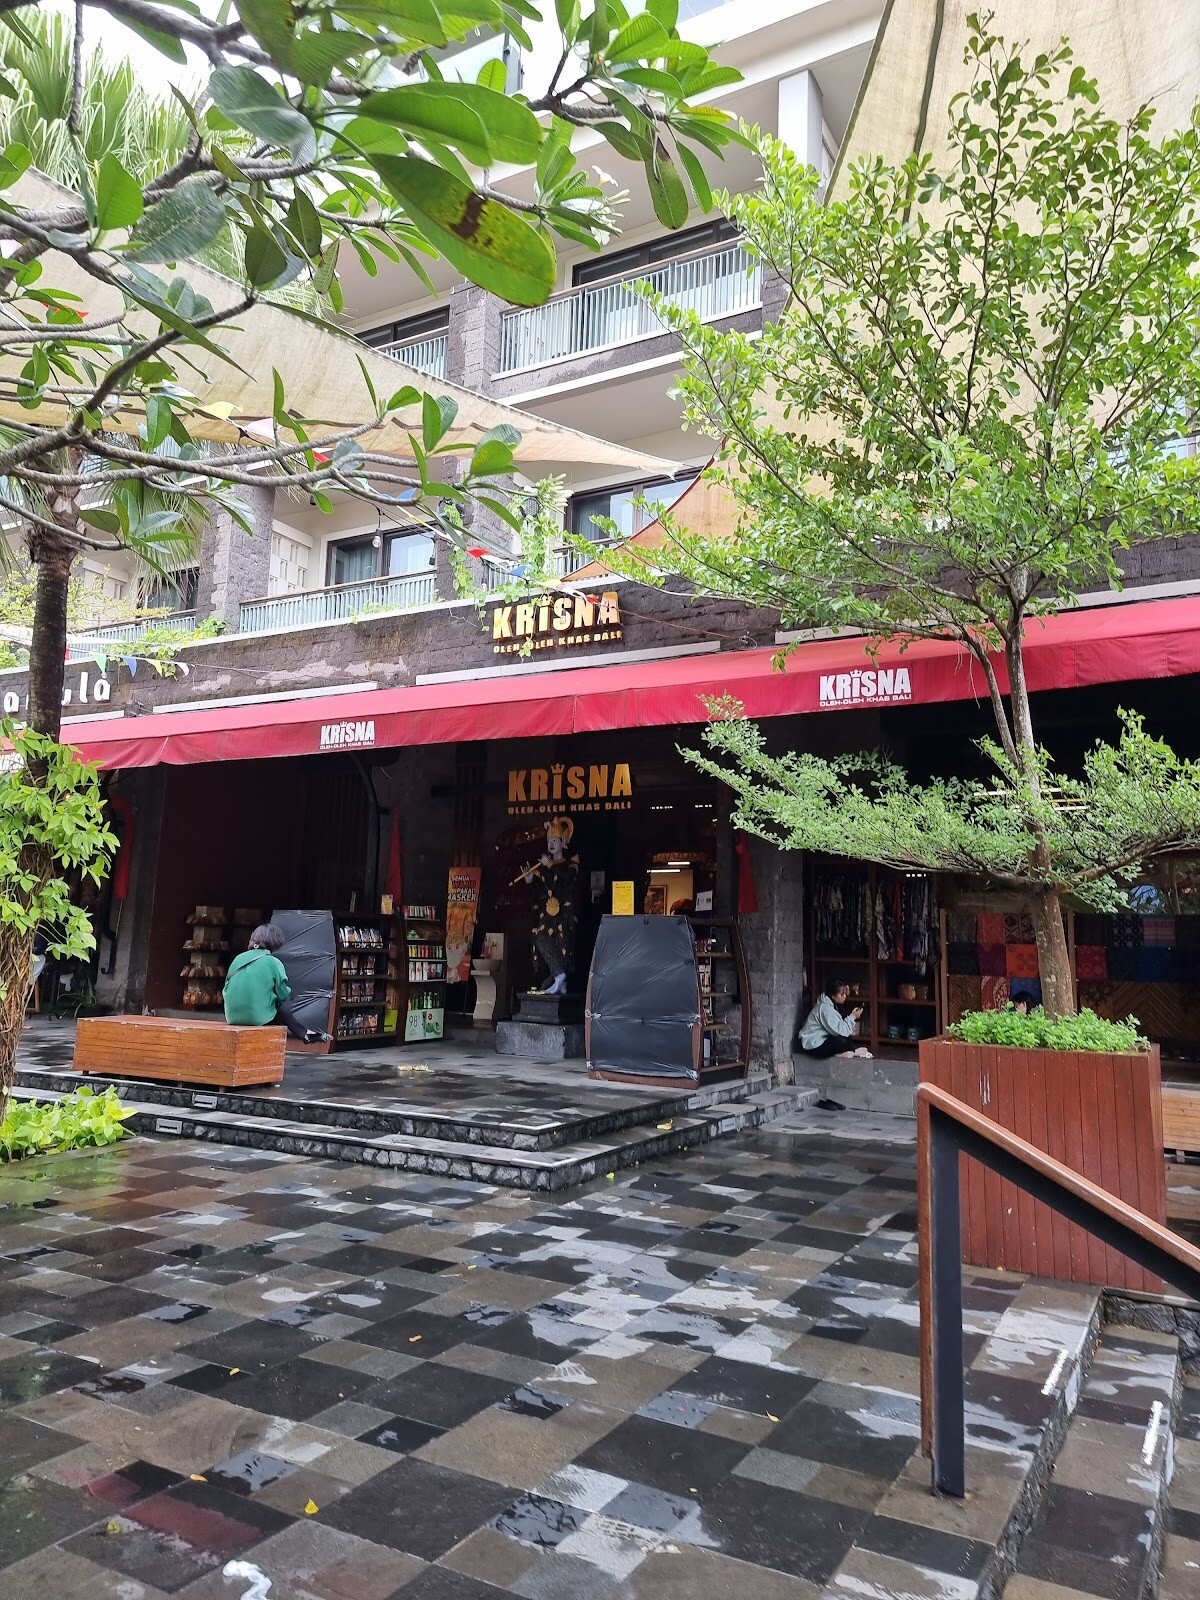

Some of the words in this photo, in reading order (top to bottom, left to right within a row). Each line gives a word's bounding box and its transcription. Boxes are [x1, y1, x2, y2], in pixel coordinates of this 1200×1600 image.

[559, 633, 591, 646] KHAS
[594, 630, 622, 641] BALI
[819, 697, 864, 706] OLEH-OLEH
[508, 804, 566, 814] OLEH-OLEH
[570, 803, 600, 812] KHAS
[605, 801, 631, 810] BALI
